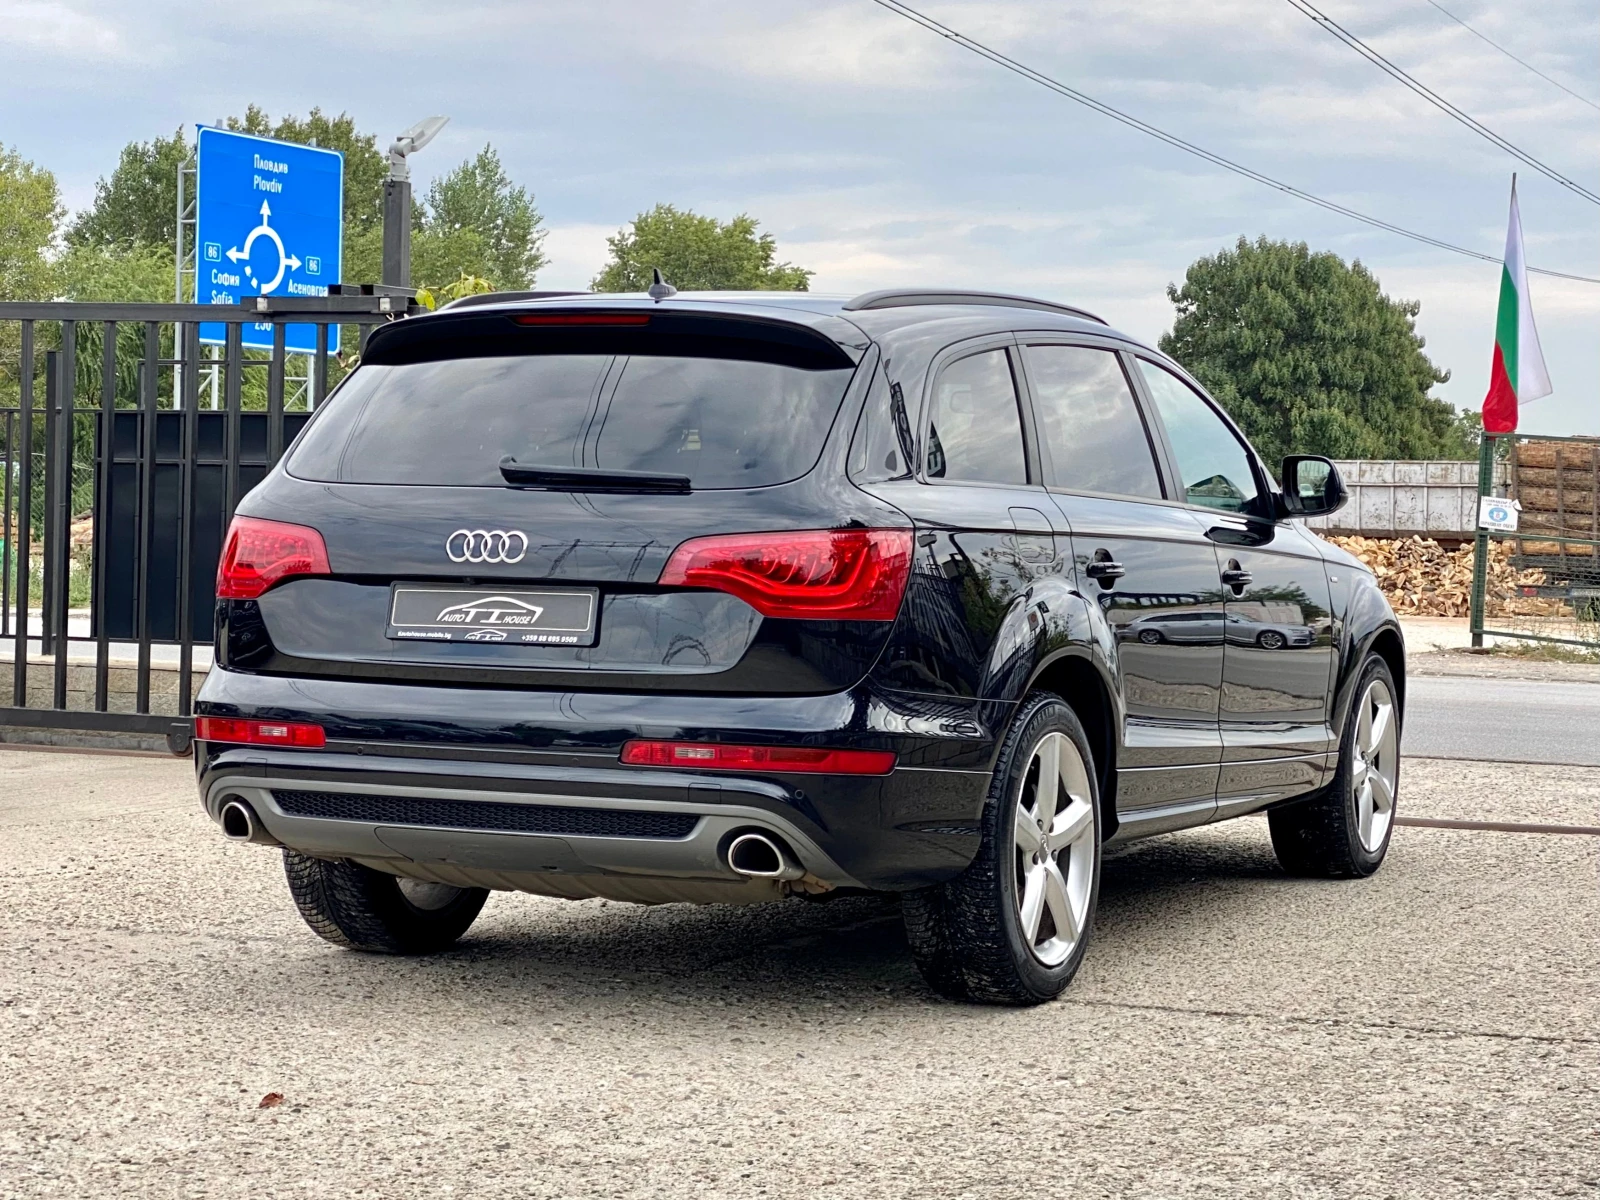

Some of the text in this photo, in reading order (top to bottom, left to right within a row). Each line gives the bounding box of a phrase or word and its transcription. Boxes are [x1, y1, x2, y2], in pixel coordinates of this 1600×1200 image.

[253, 154, 288, 174] Пловдив
[253, 175, 282, 193] Plovdiv
[208, 246, 218, 259] 86
[309, 259, 318, 272] 86
[211, 269, 240, 287] София
[287, 279, 328, 297] Асеновгра
[211, 290, 233, 304] Sofia
[441, 613, 465, 622] AUTO
[502, 615, 532, 624] HOUSE
[521, 634, 538, 642] +359
